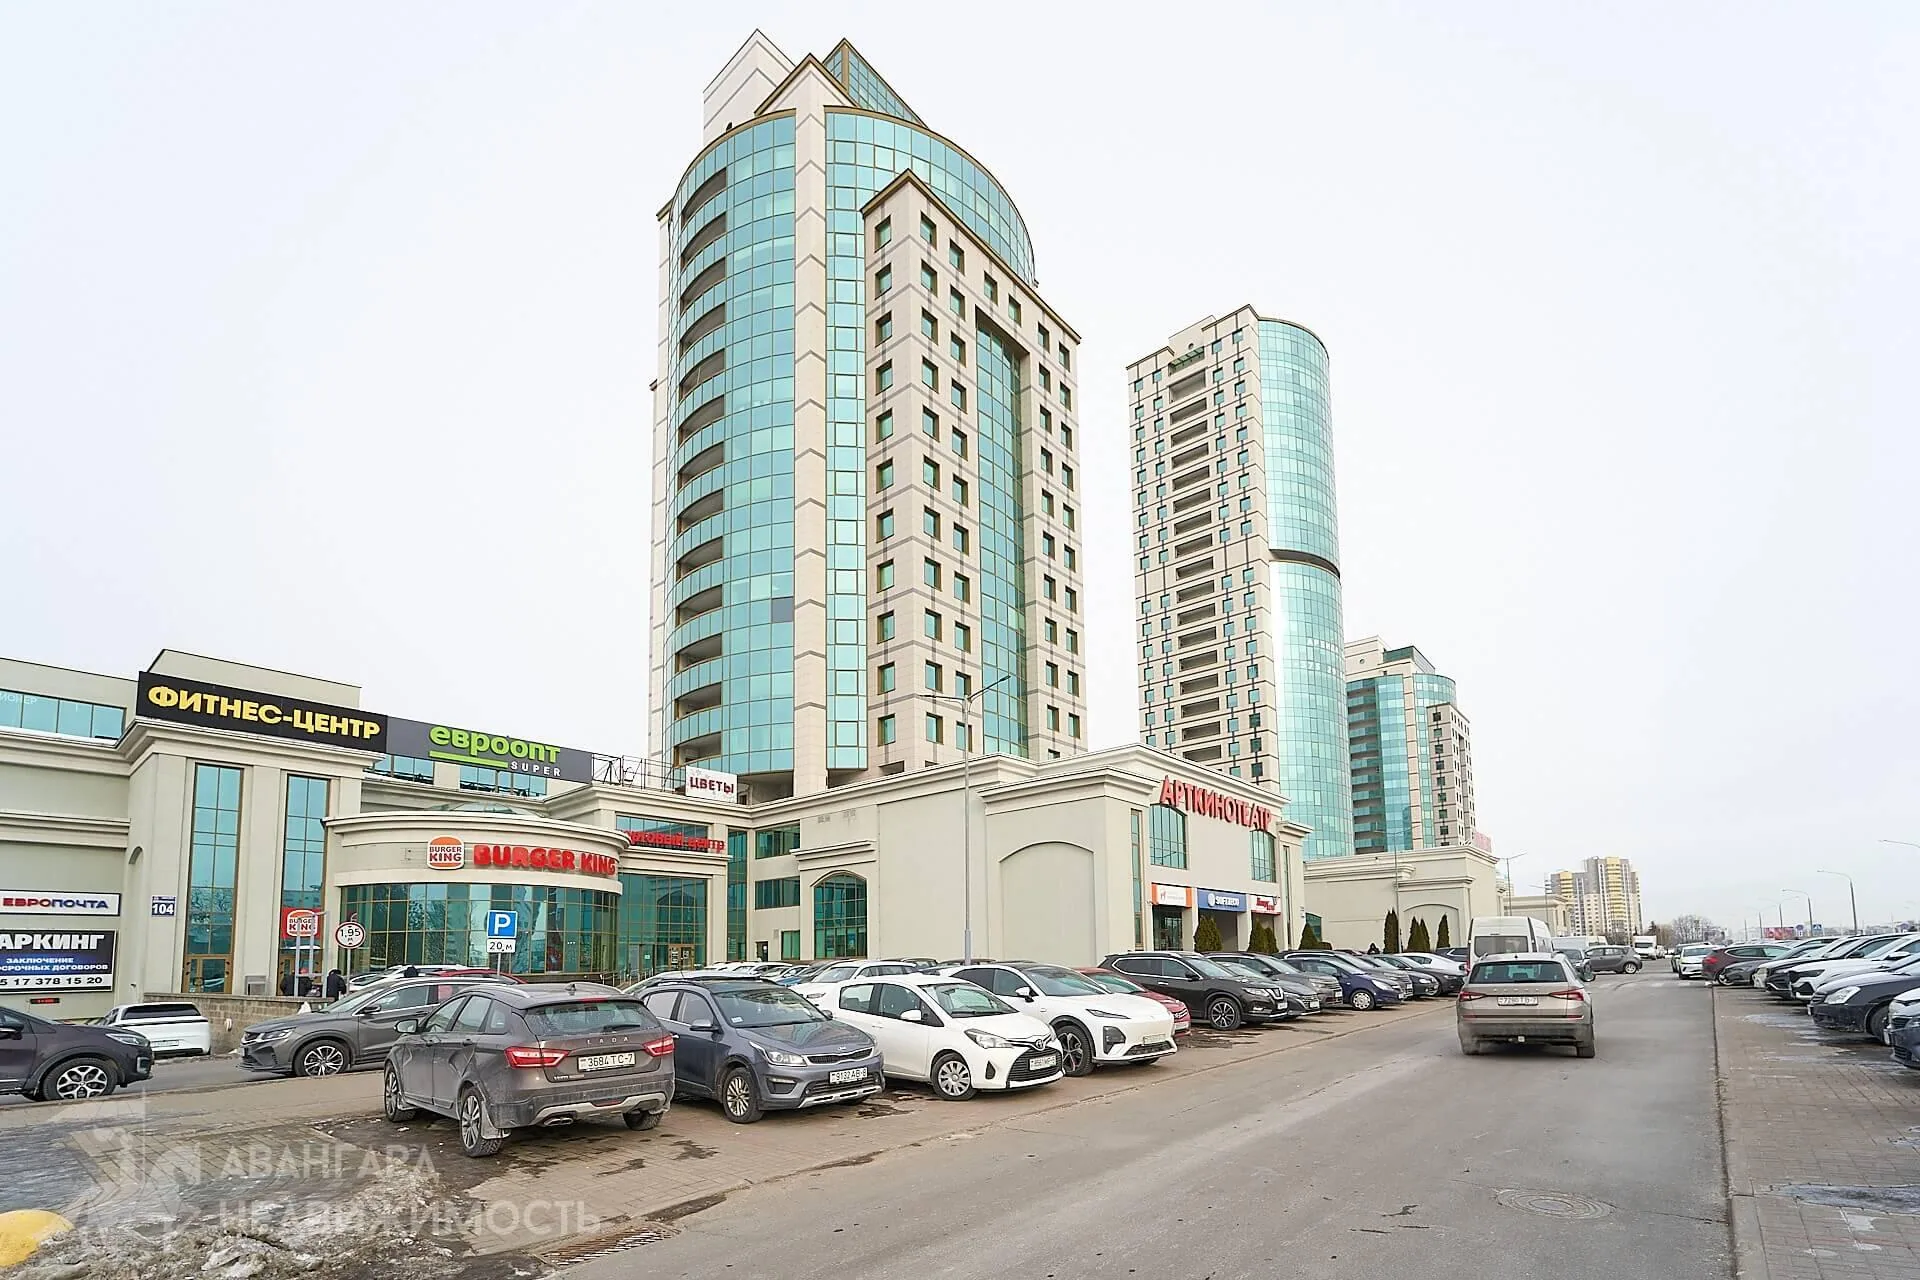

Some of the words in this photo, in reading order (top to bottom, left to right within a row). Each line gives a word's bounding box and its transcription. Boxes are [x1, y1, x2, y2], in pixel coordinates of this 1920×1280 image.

[148, 685, 381, 739] ФИТНЕС-ЦЕНТР
[429, 725, 560, 763] евроопт
[510, 761, 562, 777] SUPER
[688, 776, 735, 793] ЦВЕТЫ
[1160, 775, 1272, 831] АРТКИНОТЕАТР
[429, 852, 462, 862] KING
[473, 845, 576, 870] BURGER
[579, 852, 616, 875] KING
[3, 898, 108, 909] ЕВРОПОЧТА
[152, 903, 174, 914] 104
[0, 934, 104, 949] АРКИНГ
[490, 942, 502, 950] 20
[35, 977, 60, 985] 378
[587, 1037, 628, 1045] LADA
